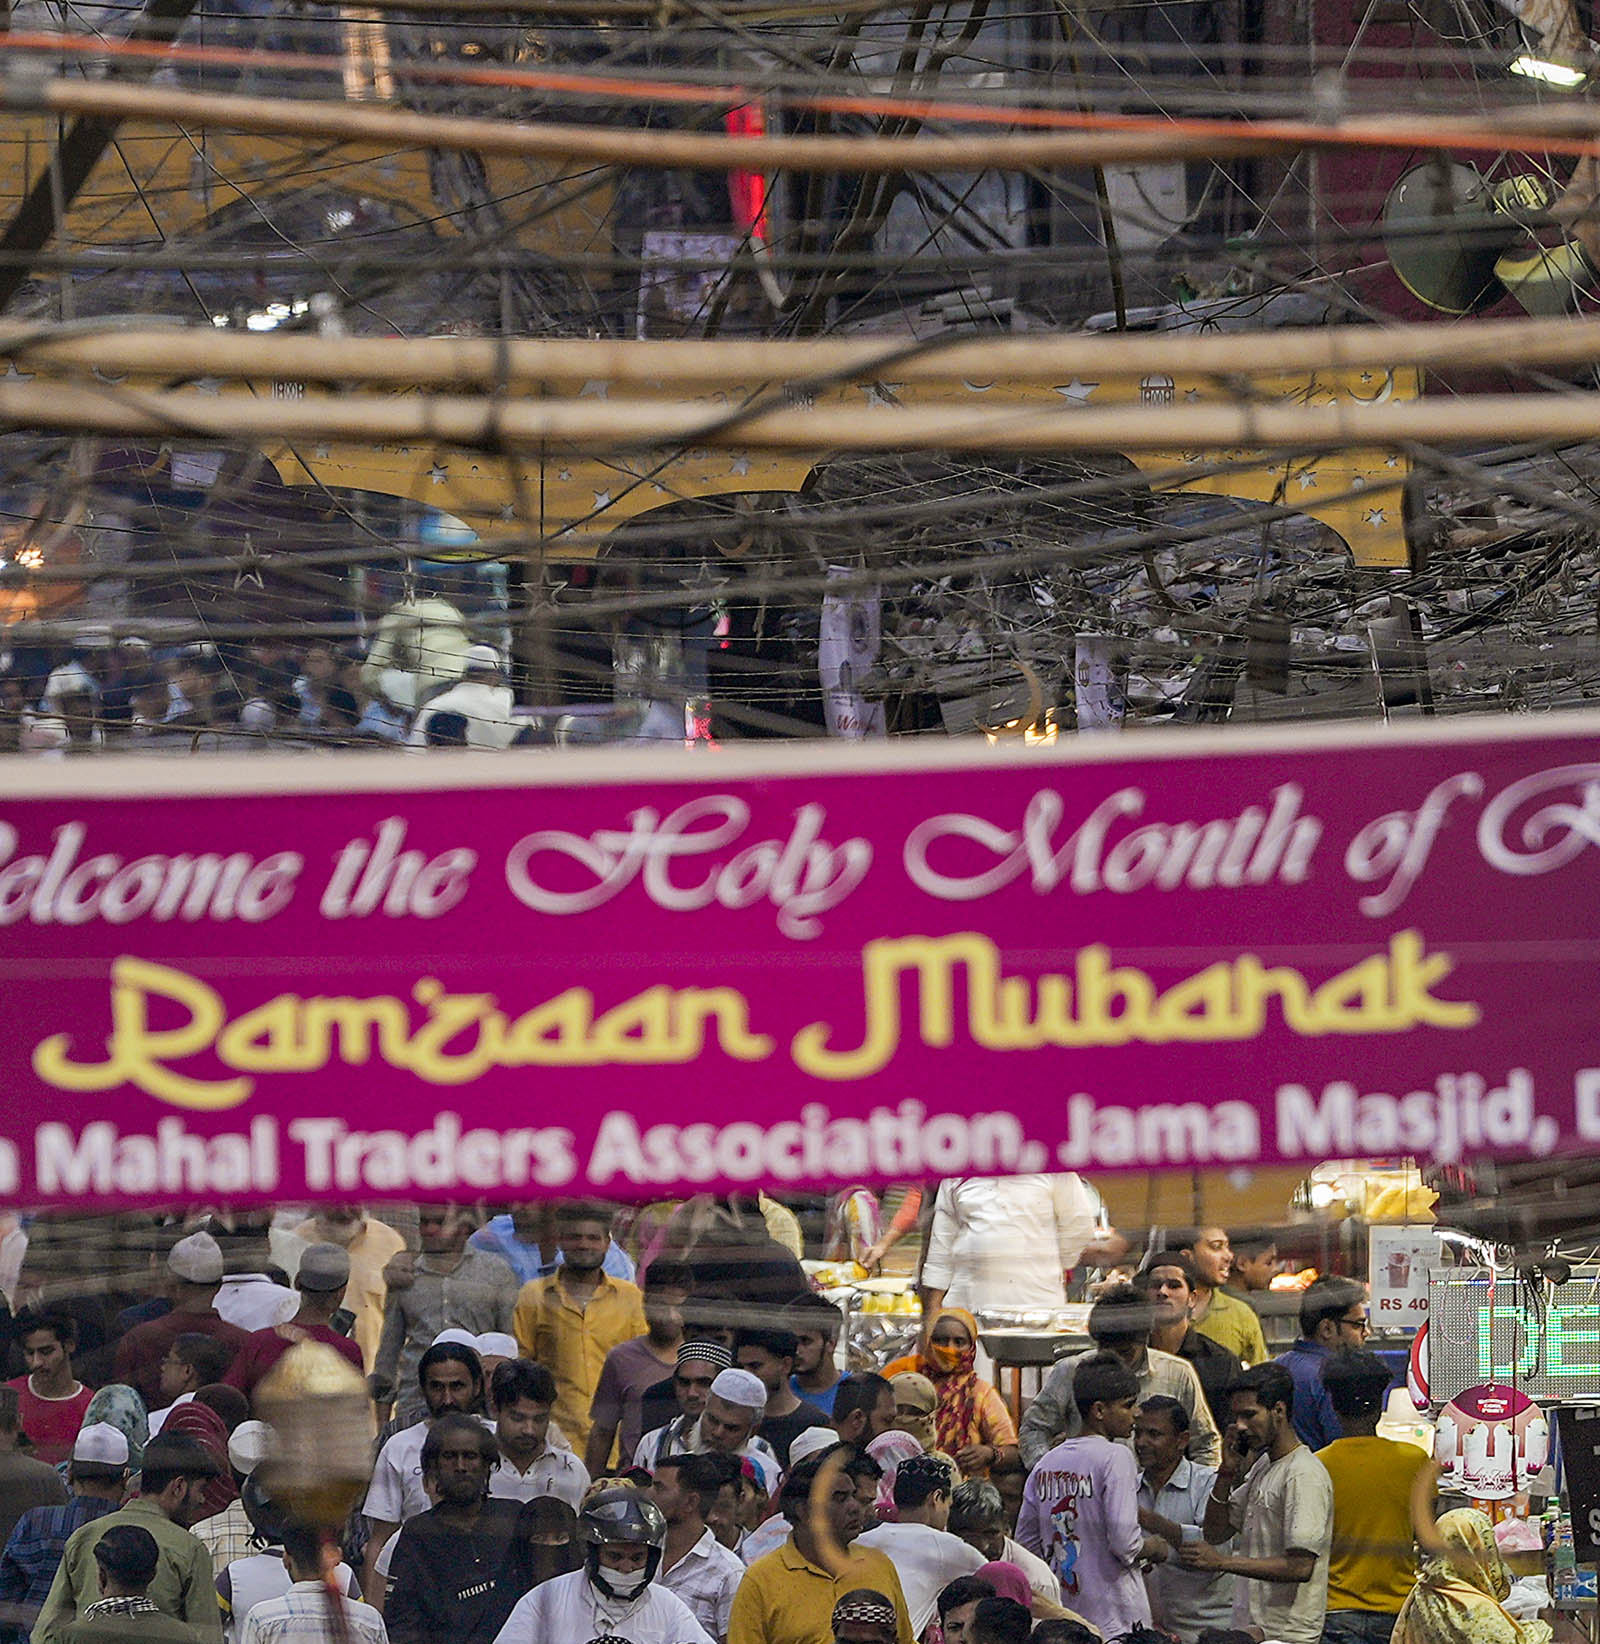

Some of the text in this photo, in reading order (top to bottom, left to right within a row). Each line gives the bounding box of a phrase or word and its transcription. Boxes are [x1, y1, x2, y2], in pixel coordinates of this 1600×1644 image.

[317, 814, 479, 920] the
[503, 793, 876, 940] Holy
[902, 780, 1324, 903] Month
[1344, 771, 1486, 918] of
[789, 926, 1482, 1082] Mubarak
[33, 1114, 278, 1199] Mahal
[289, 1110, 577, 1191] Traders
[584, 1098, 1048, 1183] Association,
[1057, 1091, 1261, 1167] Jama
[1275, 1066, 1560, 1164] Masjid,
[1379, 1297, 1429, 1311] RS 40
